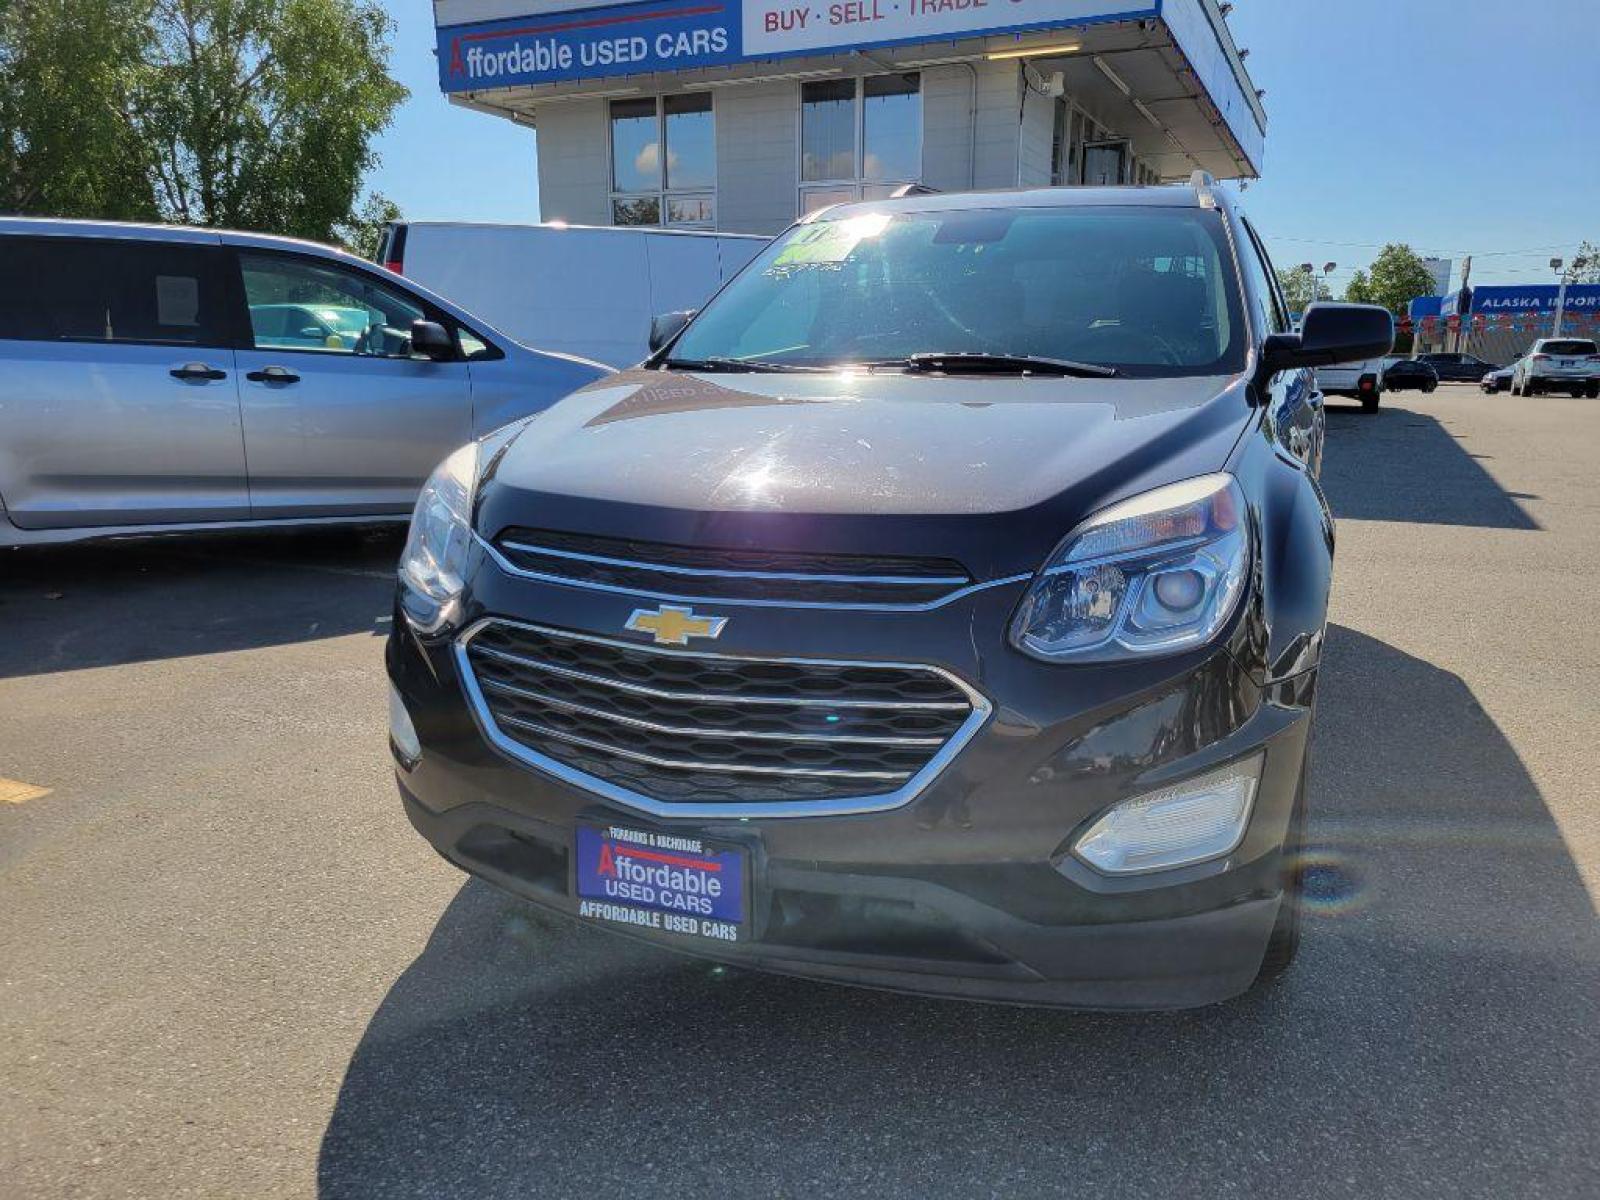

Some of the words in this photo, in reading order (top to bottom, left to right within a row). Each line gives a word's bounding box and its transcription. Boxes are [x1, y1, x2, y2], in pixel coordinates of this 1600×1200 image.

[765, 8, 809, 32] BUY
[829, 0, 885, 25] SELL
[450, 37, 573, 78] Affordable
[580, 36, 648, 67] USED
[655, 27, 729, 59] CARS
[1482, 298, 1540, 307] ALASKA
[597, 843, 721, 897] Affordable
[605, 879, 655, 902] USED
[660, 890, 713, 915] CARS
[580, 900, 660, 928] AFFORDABLE
[664, 915, 698, 935] USED
[702, 921, 737, 941] CARS
